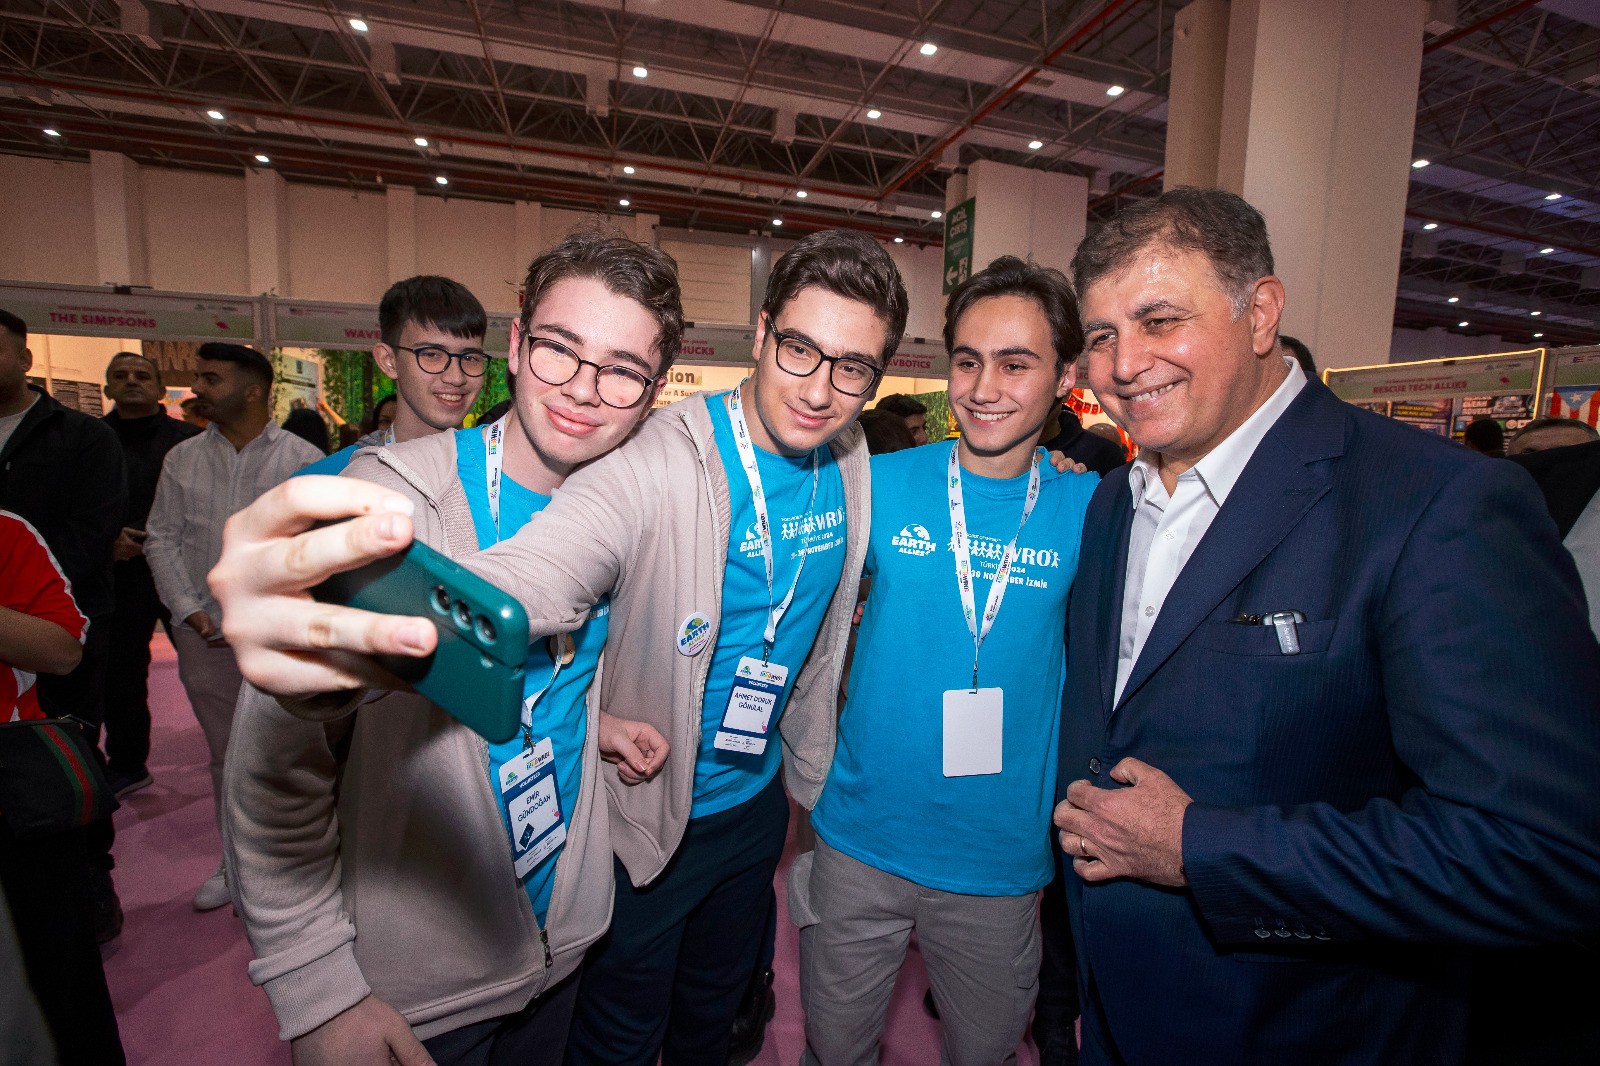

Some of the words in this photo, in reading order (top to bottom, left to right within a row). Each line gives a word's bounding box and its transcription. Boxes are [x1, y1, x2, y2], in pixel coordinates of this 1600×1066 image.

[50, 312, 78, 324] THE
[81, 314, 157, 328] SIMPSONS
[667, 368, 695, 384] ion
[1408, 383, 1432, 393] TECH
[891, 535, 937, 552] EARTH
[898, 547, 925, 557] ALLIES
[979, 560, 999, 570] TÜRKİ
[1025, 576, 1048, 589] İZMİR
[680, 621, 710, 646] EARTH
[734, 692, 753, 703] AHMET
[526, 790, 540, 805] EMİR
[517, 794, 551, 822] GÜNDOĞAN
